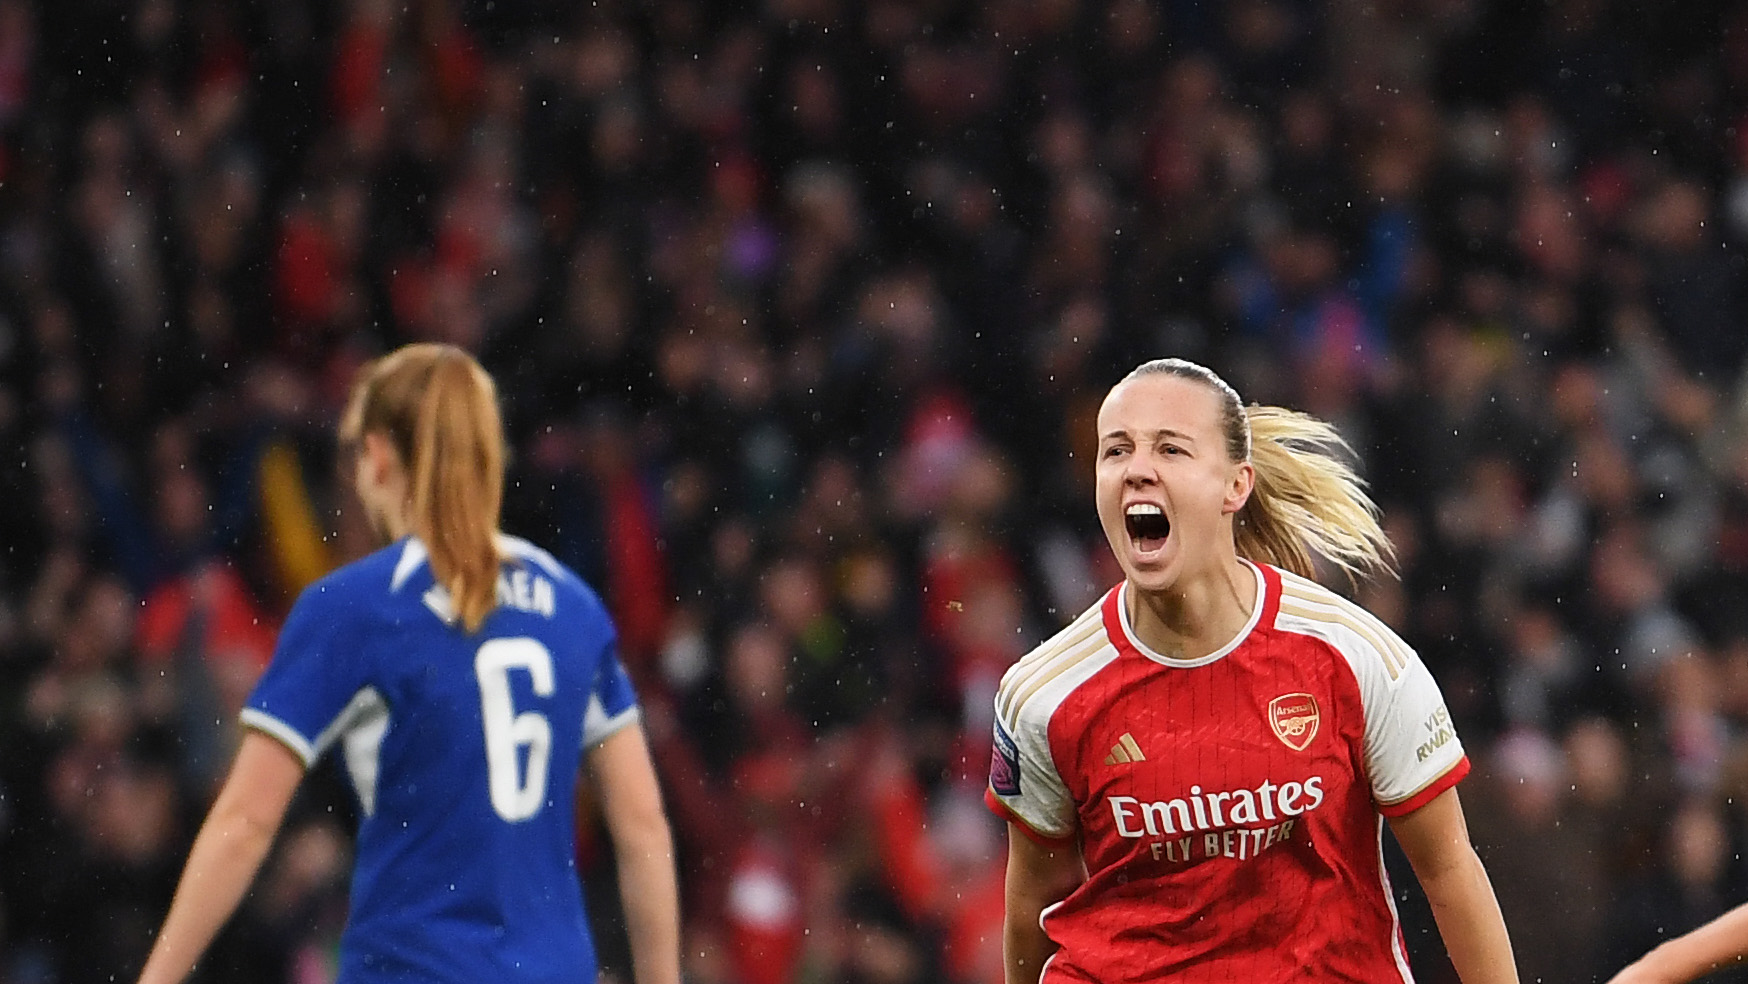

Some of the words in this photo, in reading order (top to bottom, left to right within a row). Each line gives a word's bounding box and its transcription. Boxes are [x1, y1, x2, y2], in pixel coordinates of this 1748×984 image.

[475, 637, 555, 822] 6
[1107, 776, 1324, 838] Emirates
[1151, 836, 1192, 863] FLY
[1204, 820, 1295, 861] BETTER
